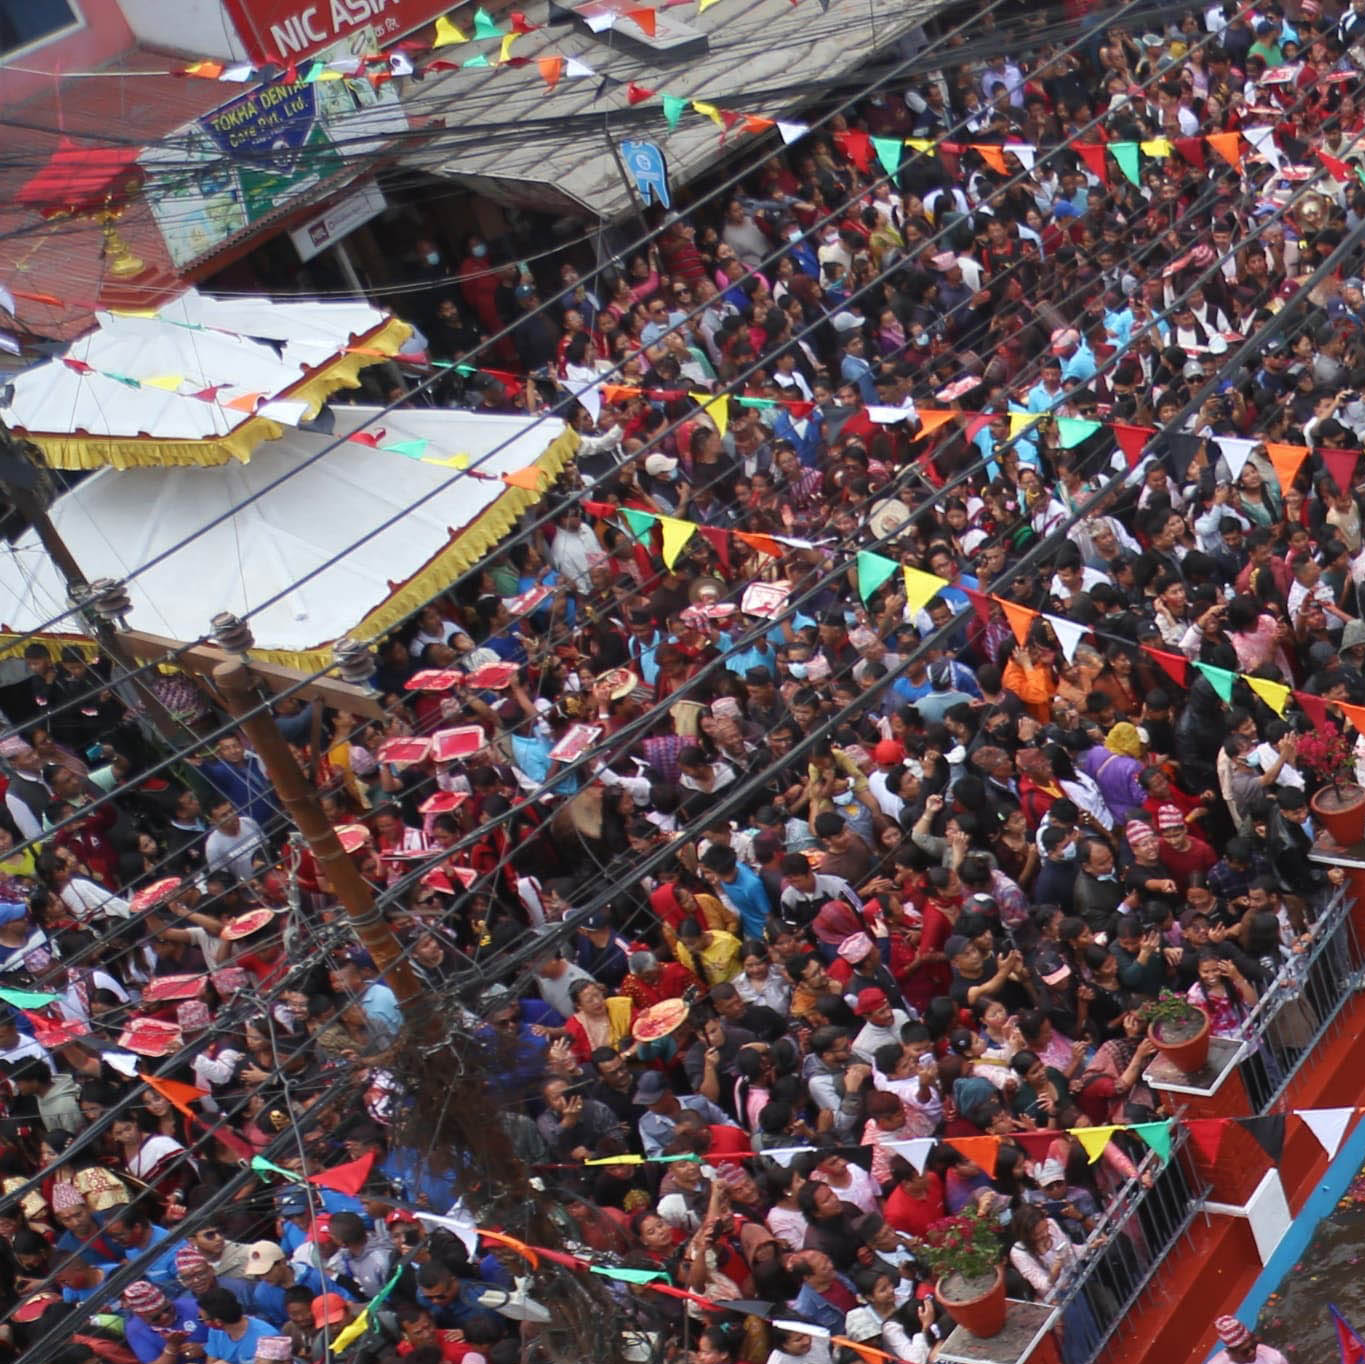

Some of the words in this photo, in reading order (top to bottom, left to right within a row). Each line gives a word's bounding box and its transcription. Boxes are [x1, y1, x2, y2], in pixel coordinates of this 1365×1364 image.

[270, 8, 327, 58] NIC
[330, 0, 400, 34] AS
[211, 102, 258, 131] TOKHA
